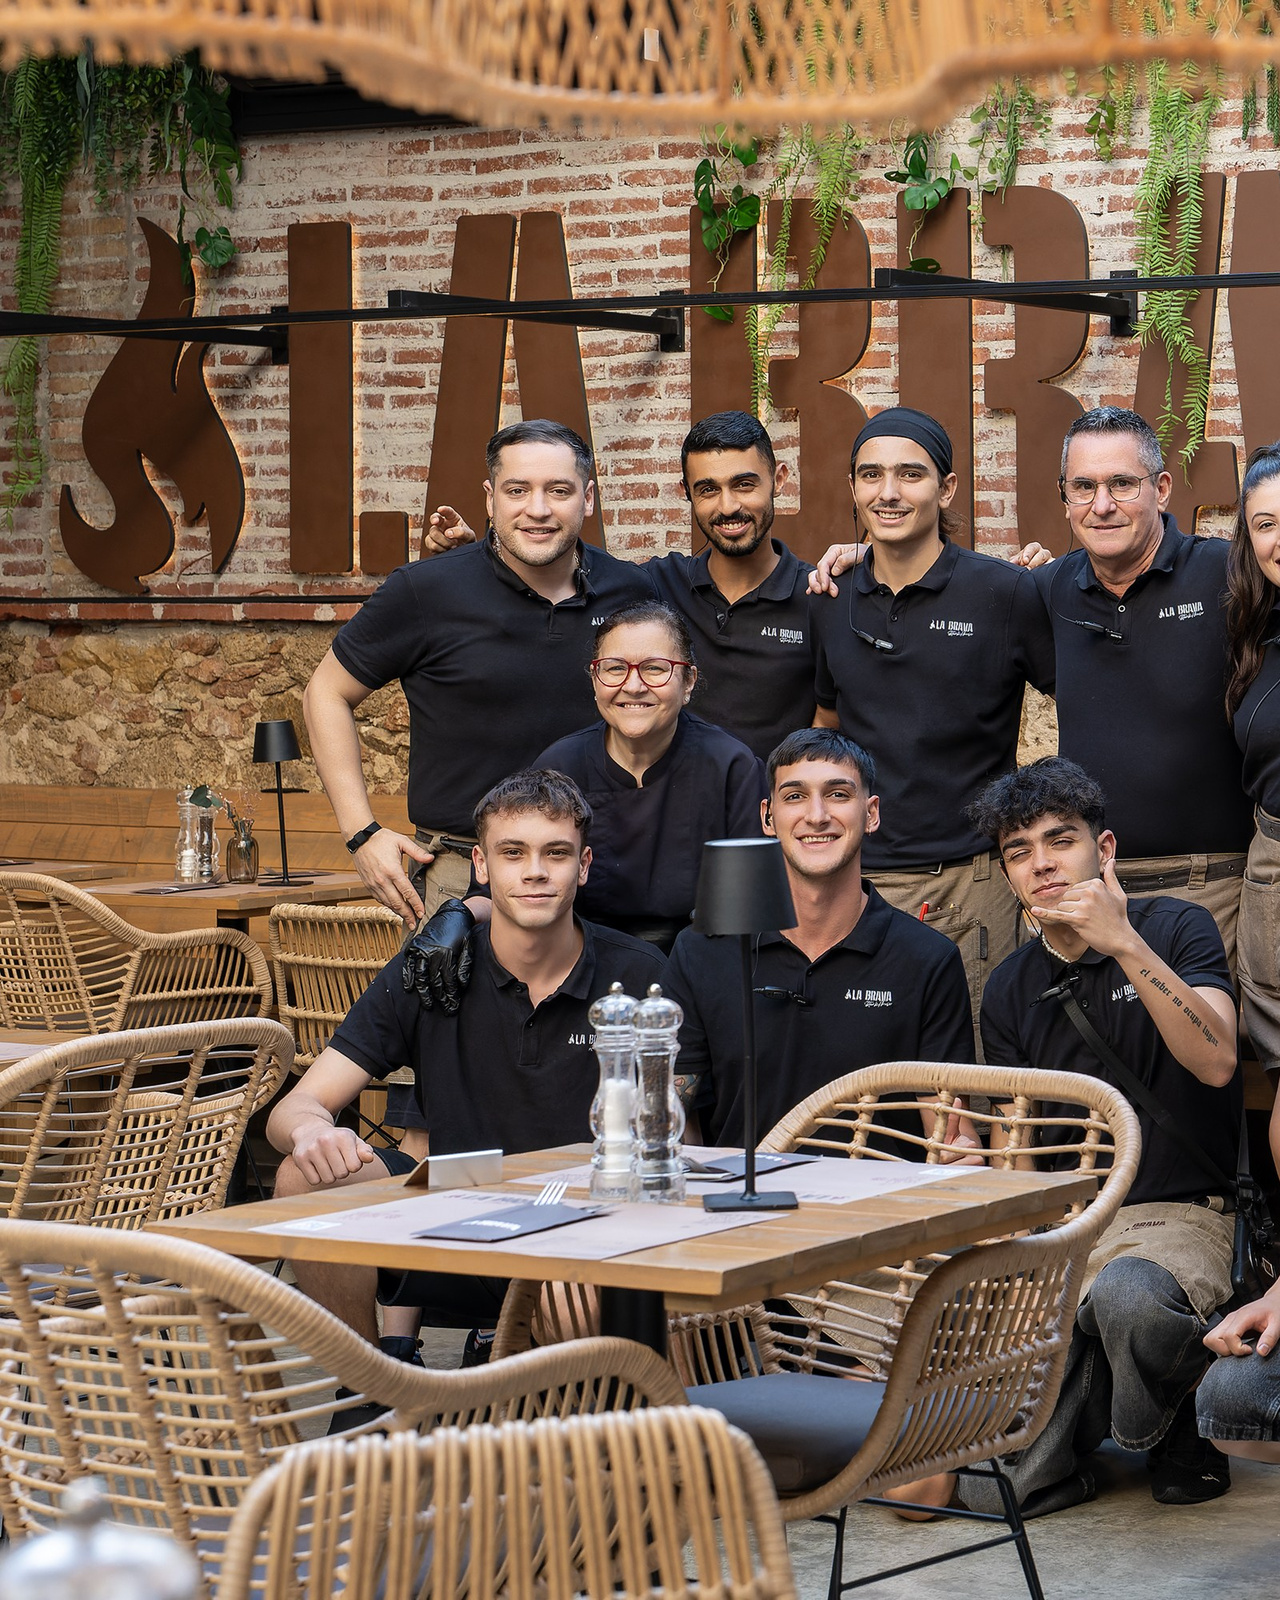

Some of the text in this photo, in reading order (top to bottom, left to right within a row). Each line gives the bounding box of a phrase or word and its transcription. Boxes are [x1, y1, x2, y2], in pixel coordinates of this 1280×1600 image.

[287, 211, 607, 574] LA
[1165, 601, 1204, 618] LA BRAVA
[767, 626, 803, 640] LA BRAVA
[936, 620, 974, 632] LA BRAVA
[852, 990, 893, 1002] LA BRAVA
[1140, 968, 1151, 978] el
[1149, 976, 1173, 997] saber
[1172, 996, 1184, 1007] no
[1183, 1006, 1203, 1028] ocupa
[575, 1034, 586, 1045] LA
